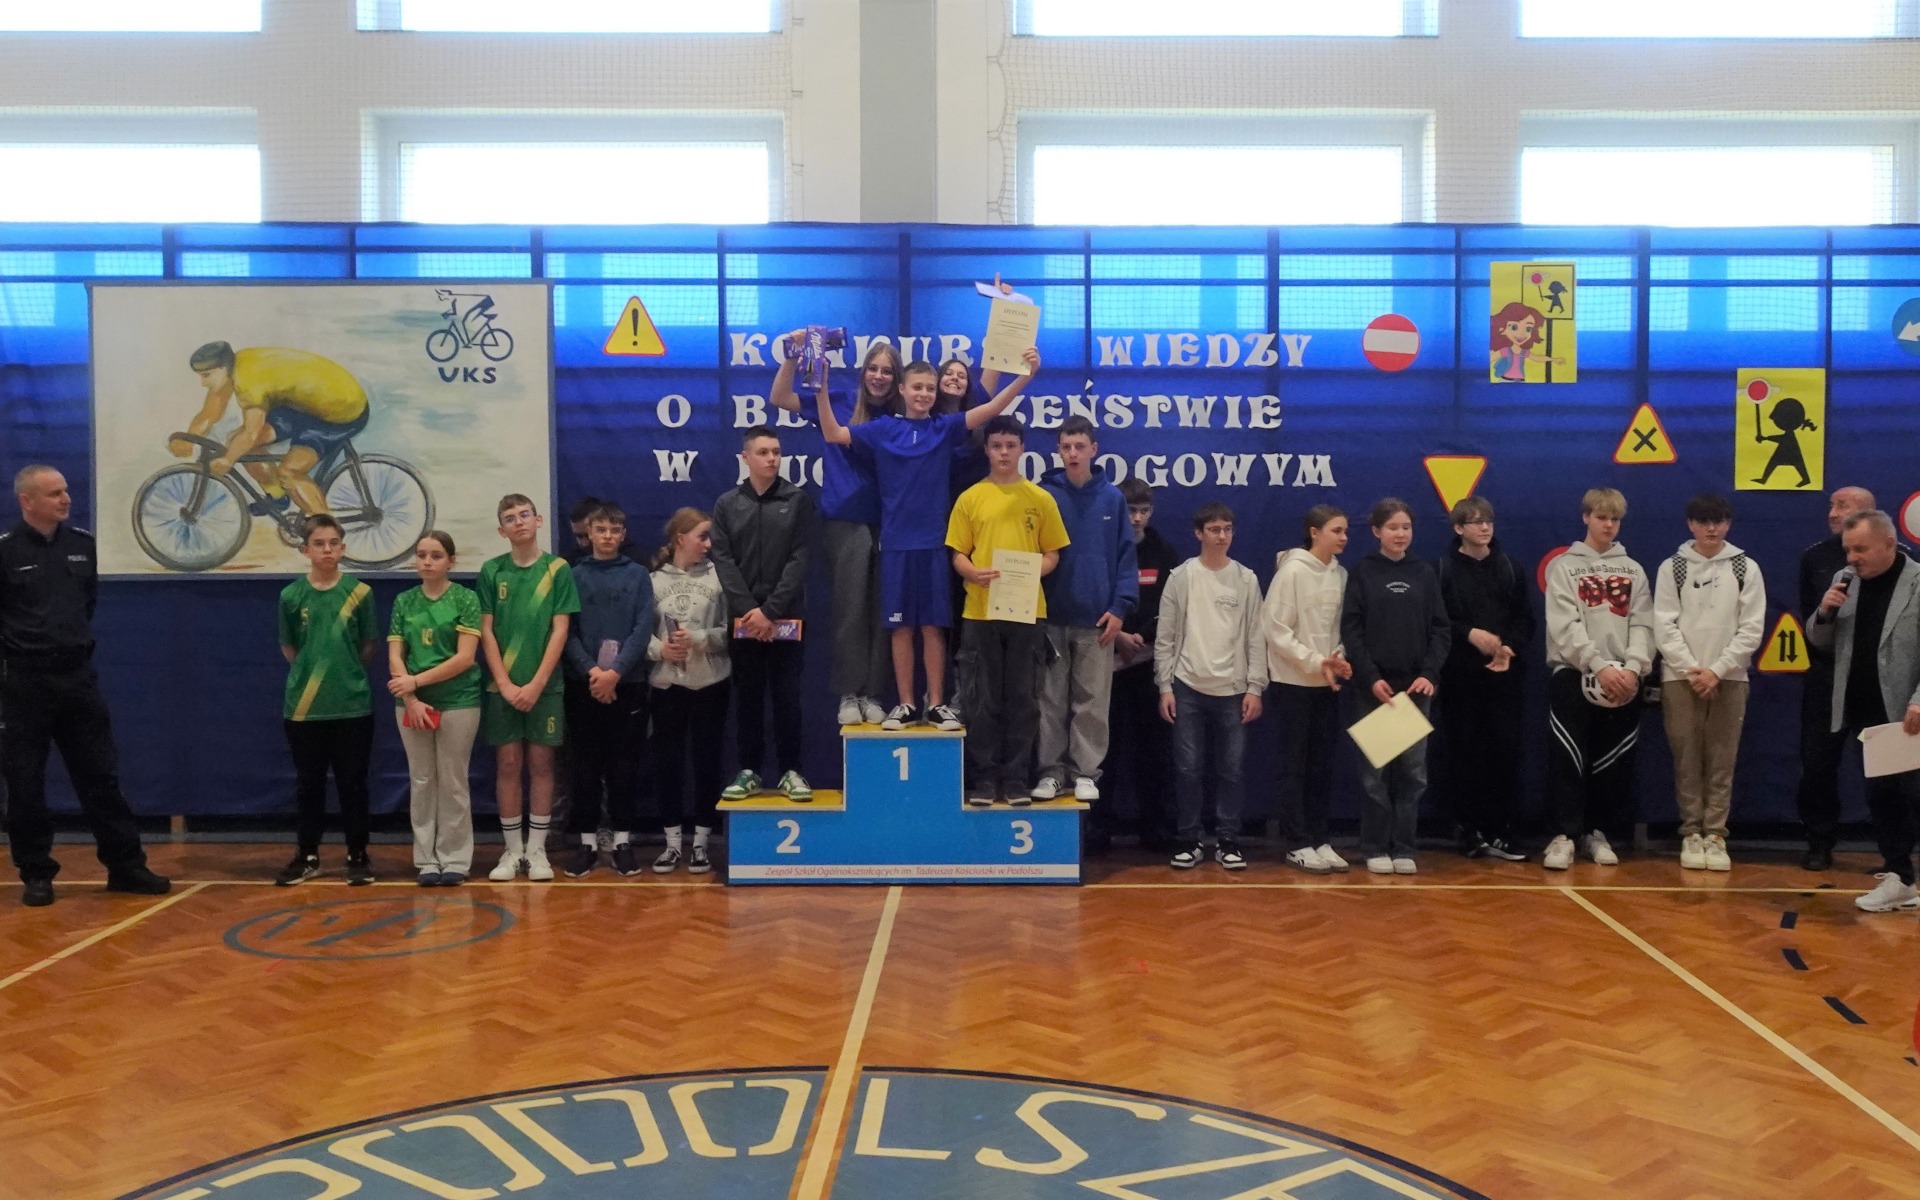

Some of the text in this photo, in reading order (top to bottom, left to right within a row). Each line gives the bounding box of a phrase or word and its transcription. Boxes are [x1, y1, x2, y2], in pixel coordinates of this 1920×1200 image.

[1096, 332, 1313, 367] WIEDZY
[656, 394, 692, 428] O
[653, 449, 699, 482] W
[1569, 568, 1587, 577] Life
[498, 582, 507, 600] 6
[892, 747, 909, 781] 1
[776, 819, 801, 854] 2
[1009, 820, 1034, 855] 3
[765, 867, 793, 877] Zespół
[794, 867, 815, 875] Szkół
[916, 867, 953, 875] Tadeusza
[1006, 867, 1044, 875] Podolszu
